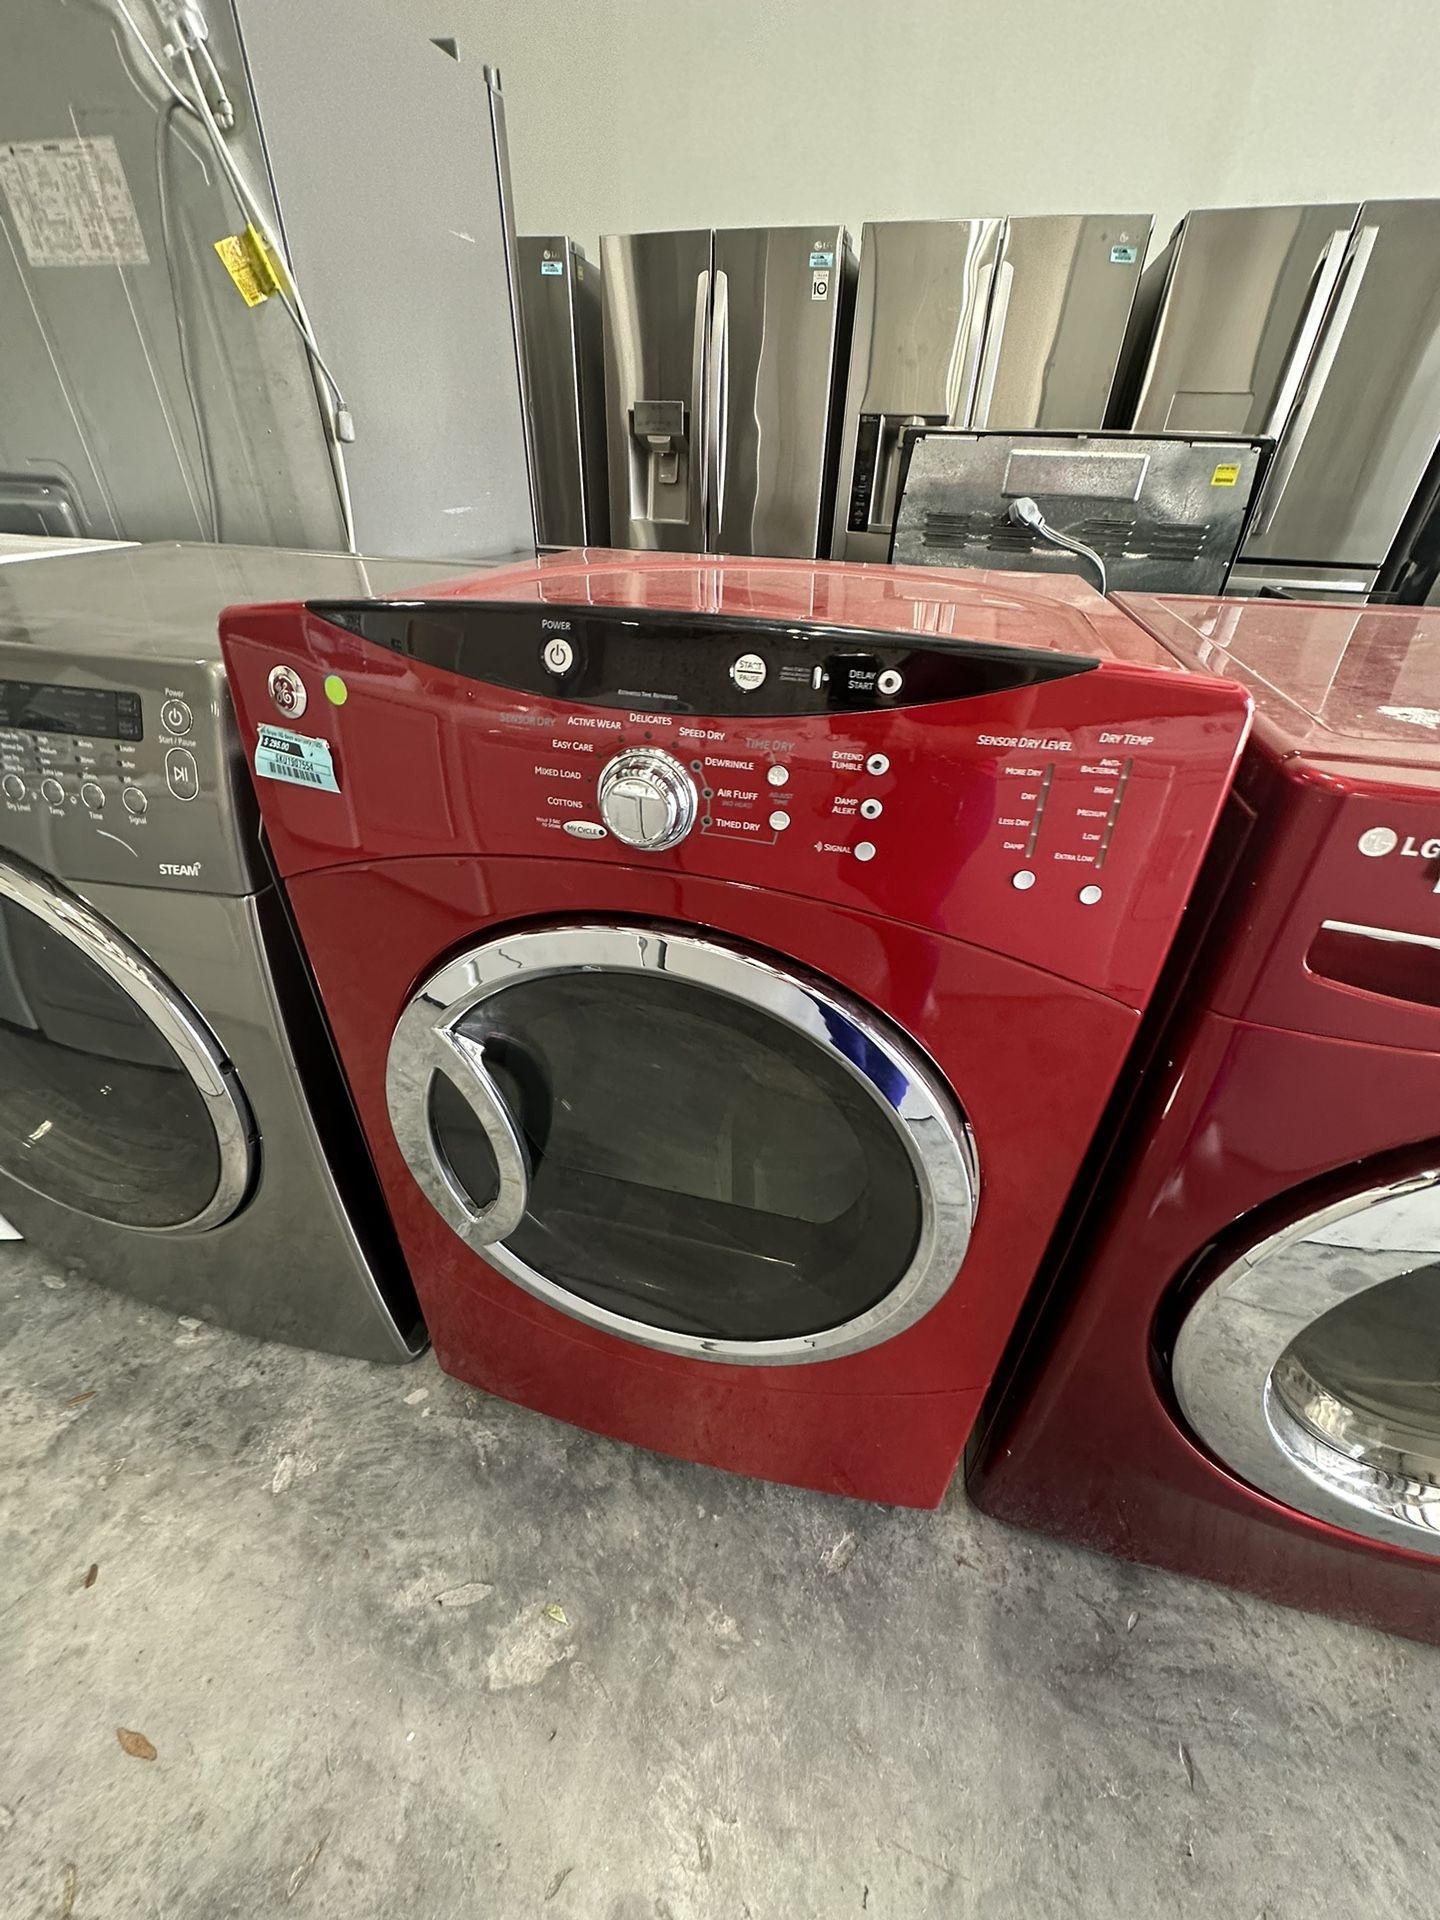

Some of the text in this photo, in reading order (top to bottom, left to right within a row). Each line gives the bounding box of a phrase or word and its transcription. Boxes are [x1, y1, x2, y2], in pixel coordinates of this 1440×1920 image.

[541, 619, 572, 630] POWER
[739, 674, 760, 683] PAUSE
[849, 669, 877, 680] DELAY
[848, 680, 875, 690] START
[165, 688, 184, 698] Power
[568, 716, 622, 730] ACTIVE WEAR
[629, 713, 673, 726] DELICATES
[679, 726, 726, 742] SPEED DRY
[1099, 732, 1154, 746] DRY TEMP
[552, 739, 594, 752] EASY CARE
[745, 738, 796, 752] TIME DRY
[976, 734, 1073, 751] SENSOR DRY LEVEL
[832, 751, 864, 761] EXTEND
[705, 757, 754, 771] DEWRINKLE
[831, 761, 863, 771] TUMBLE
[535, 766, 581, 780] MIXED LOAD
[1027, 768, 1043, 776] DRY
[717, 787, 759, 801] AIR FLUFF
[1020, 792, 1037, 801] DRY
[547, 796, 583, 809] COTTONS
[834, 796, 858, 806] DAMP
[832, 806, 857, 815] ALERT
[1076, 808, 1107, 817] MEDIUM
[716, 818, 761, 832] TIMED DRY
[998, 817, 1031, 827] LESS DRY
[578, 827, 597, 835] CYCLE
[1082, 832, 1100, 841] LOW
[824, 843, 851, 853] SIGNAL
[1003, 841, 1024, 850] DAMP
[1400, 836, 1440, 858] LG
[1054, 852, 1095, 862] EXTRA LOW
[159, 863, 200, 877] STEAM
